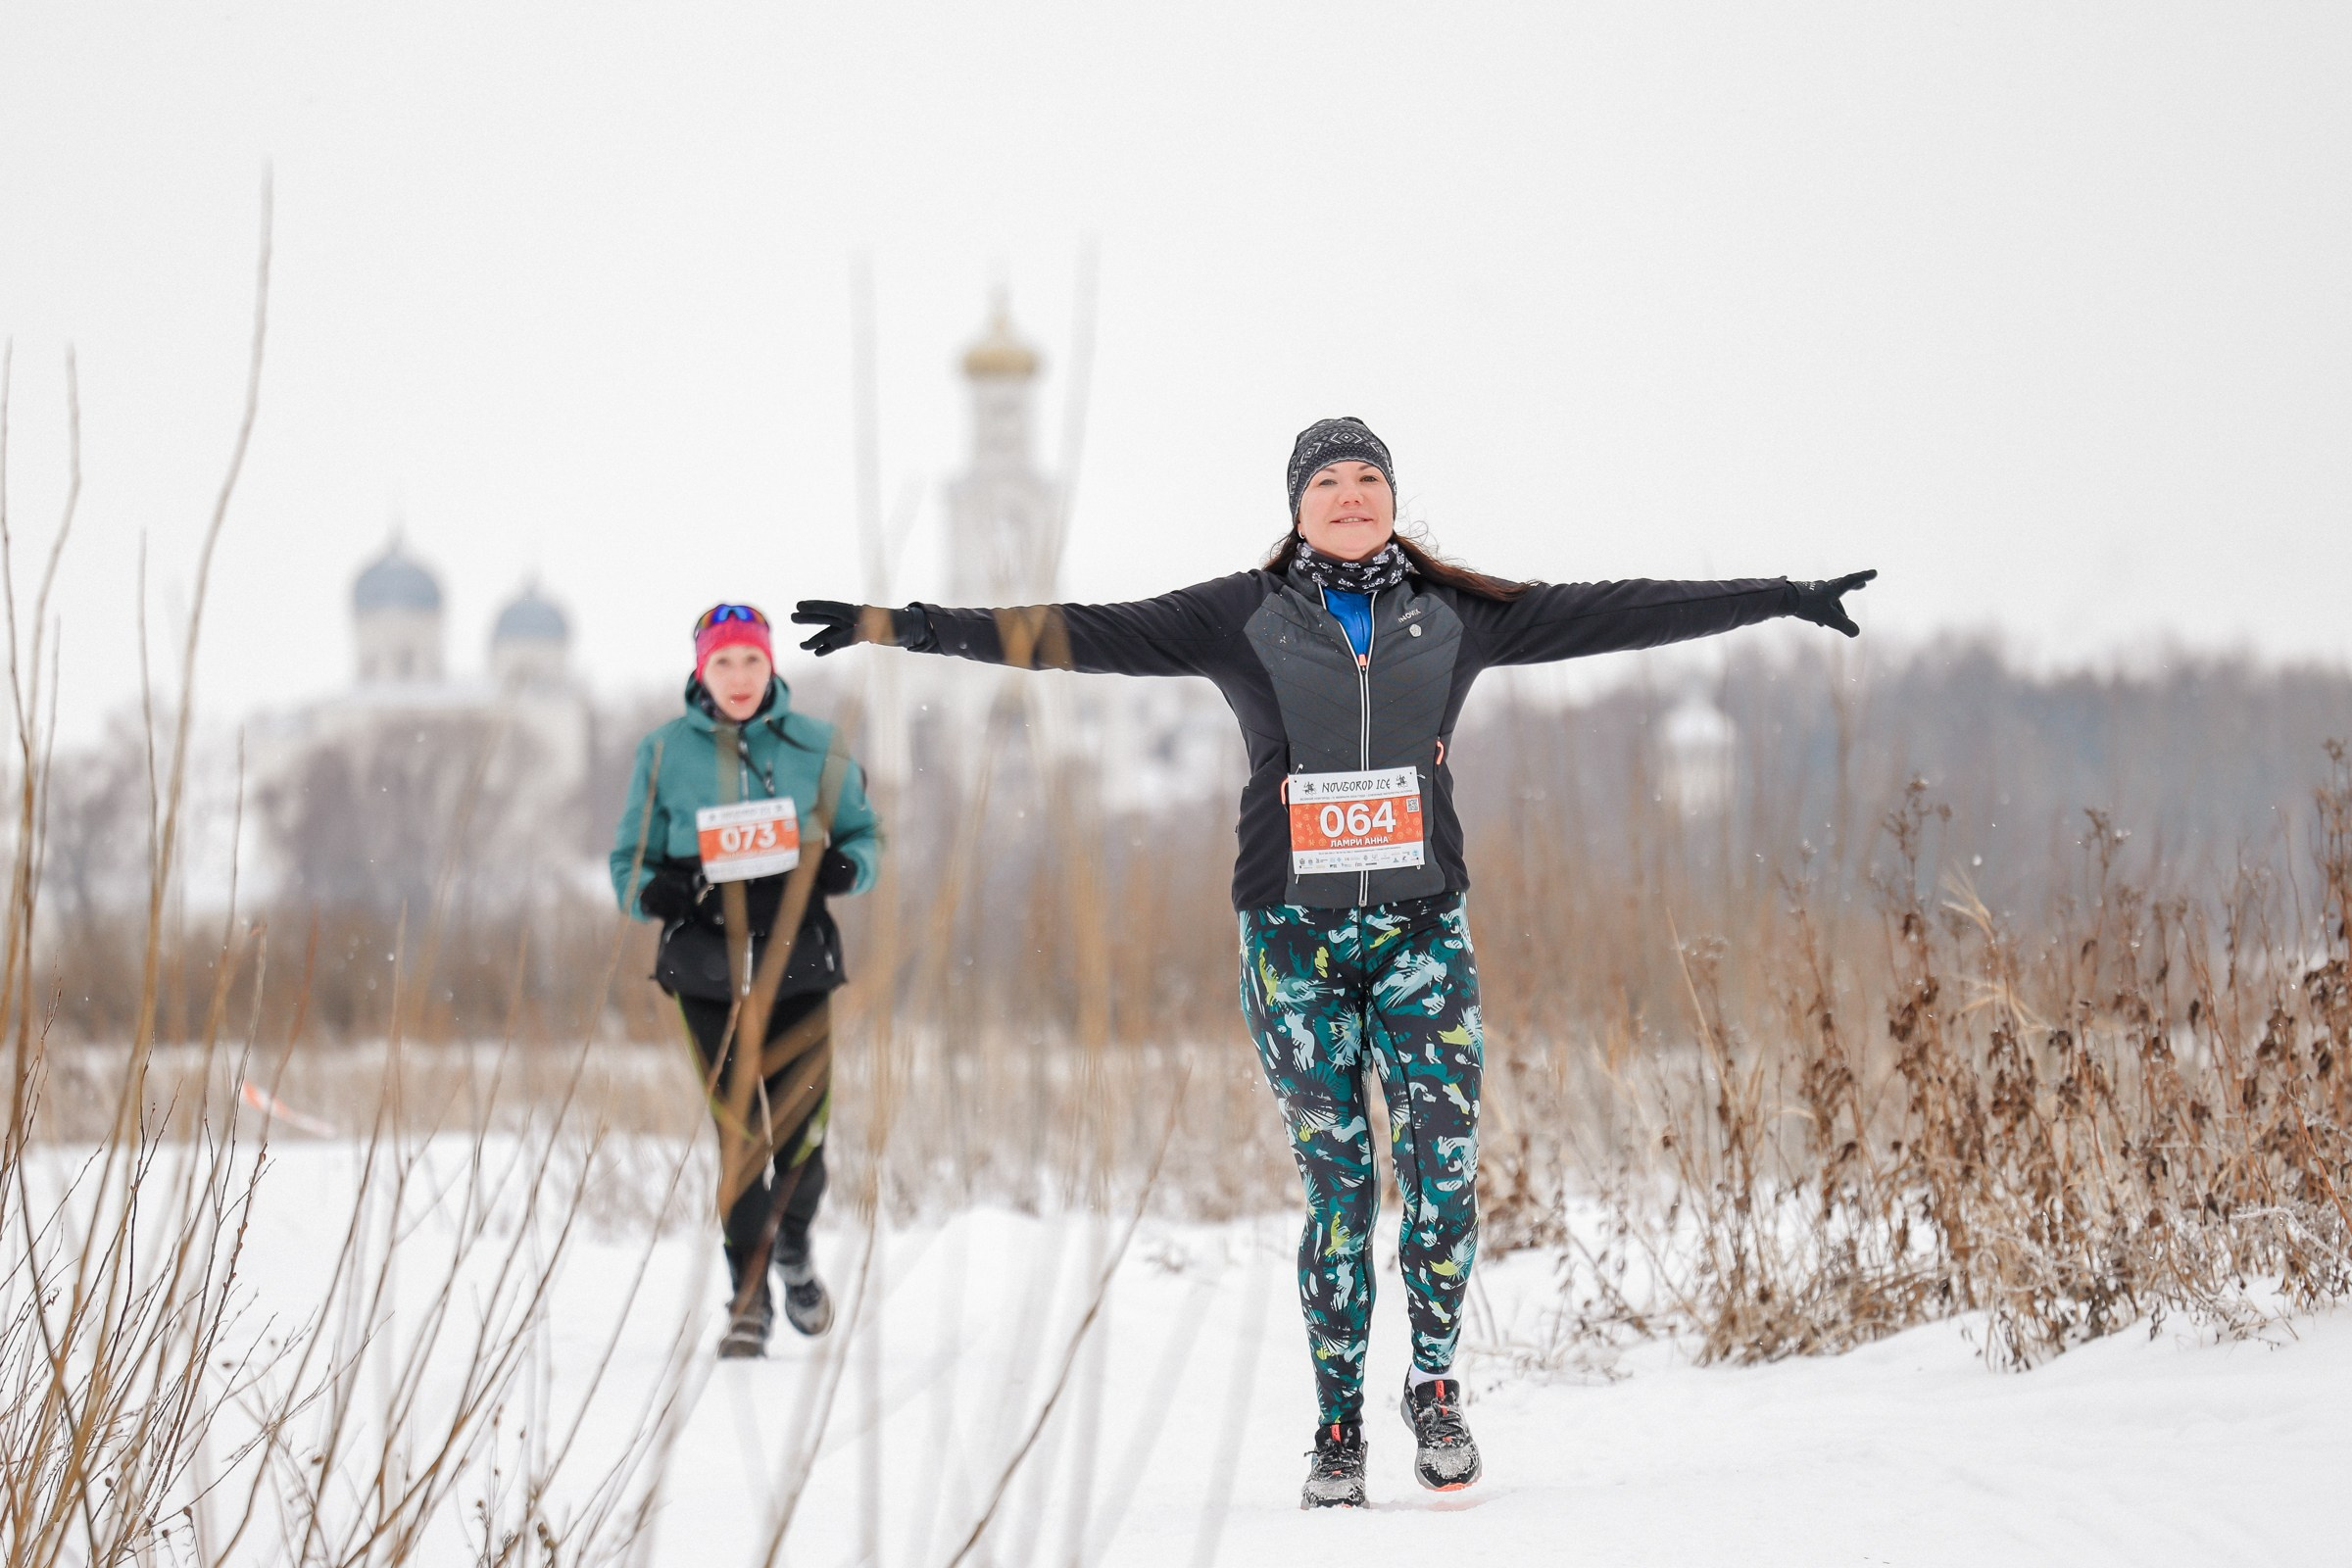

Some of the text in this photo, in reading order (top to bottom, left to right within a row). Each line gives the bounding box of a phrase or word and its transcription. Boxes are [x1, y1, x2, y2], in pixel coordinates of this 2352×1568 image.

[1376, 778, 1391, 790] ICE
[1320, 801, 1396, 837] 064
[720, 821, 777, 853] 073
[1330, 836, 1390, 848] ЛАМРИ АННА
